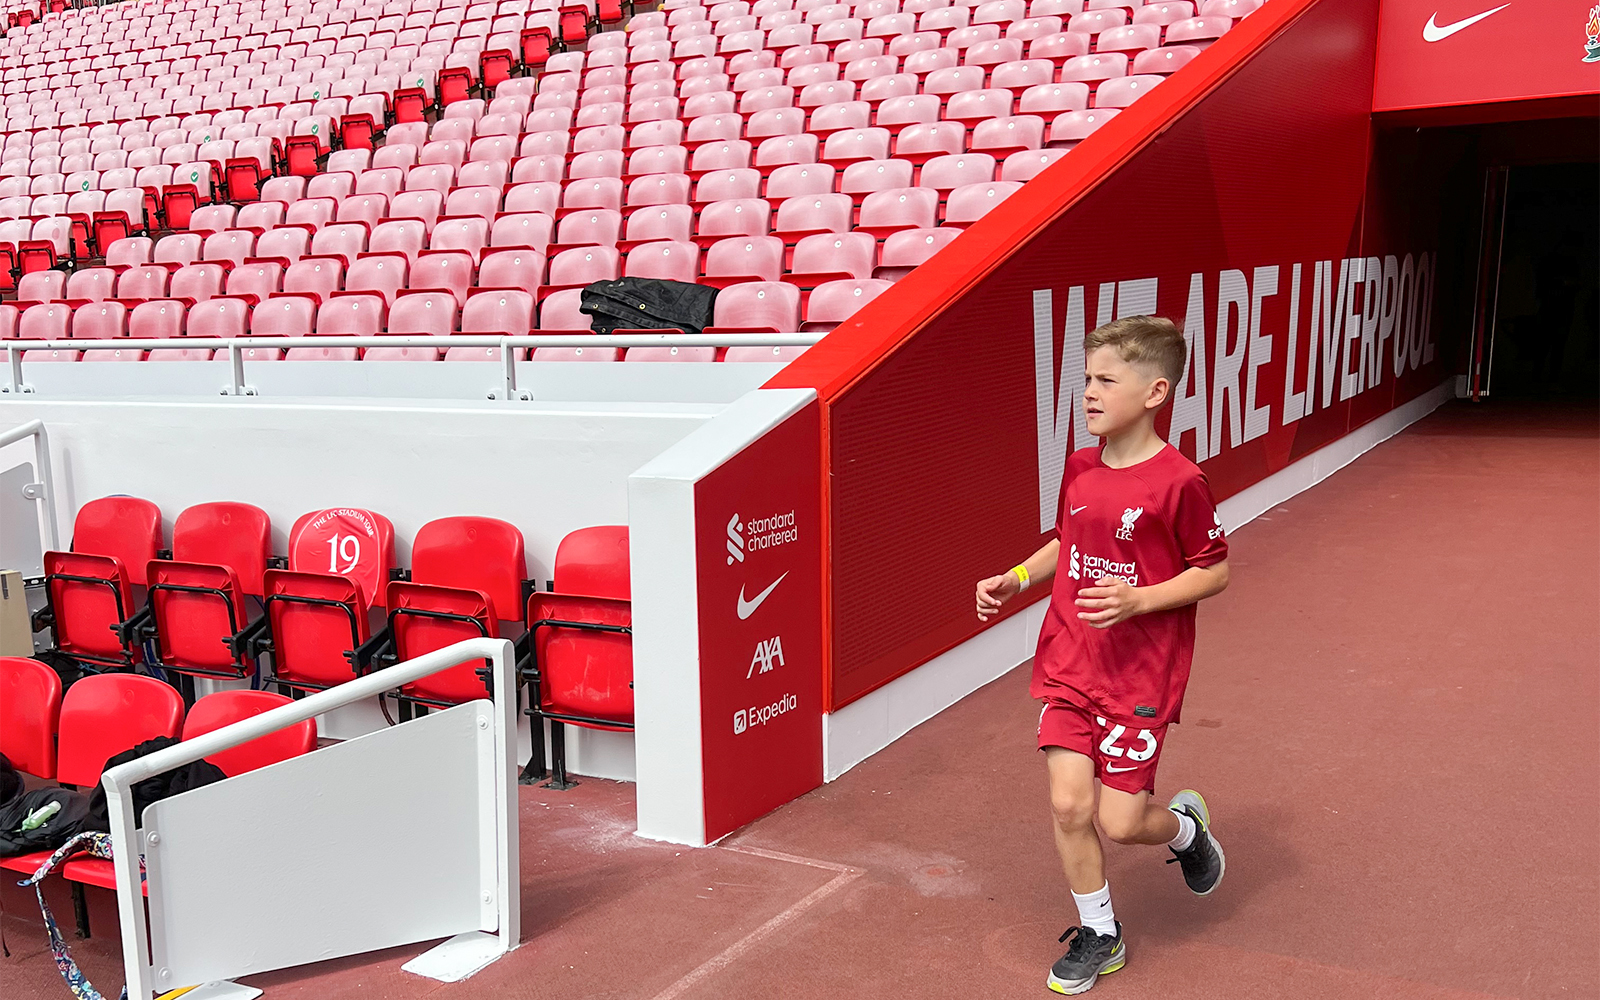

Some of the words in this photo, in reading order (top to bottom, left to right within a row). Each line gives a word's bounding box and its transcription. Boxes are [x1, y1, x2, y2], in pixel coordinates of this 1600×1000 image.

[1168, 265, 1279, 464] ARE
[1282, 251, 1438, 427] LIVERPOOL
[313, 516, 326, 529] THE
[327, 510, 337, 520] LFC
[338, 509, 364, 522] STADIUM
[364, 519, 374, 537] TOUR
[747, 509, 795, 536] standard
[748, 525, 798, 552] chartered
[327, 533, 360, 574] 19
[746, 635, 785, 680] AXA
[749, 693, 797, 728] Expedia
